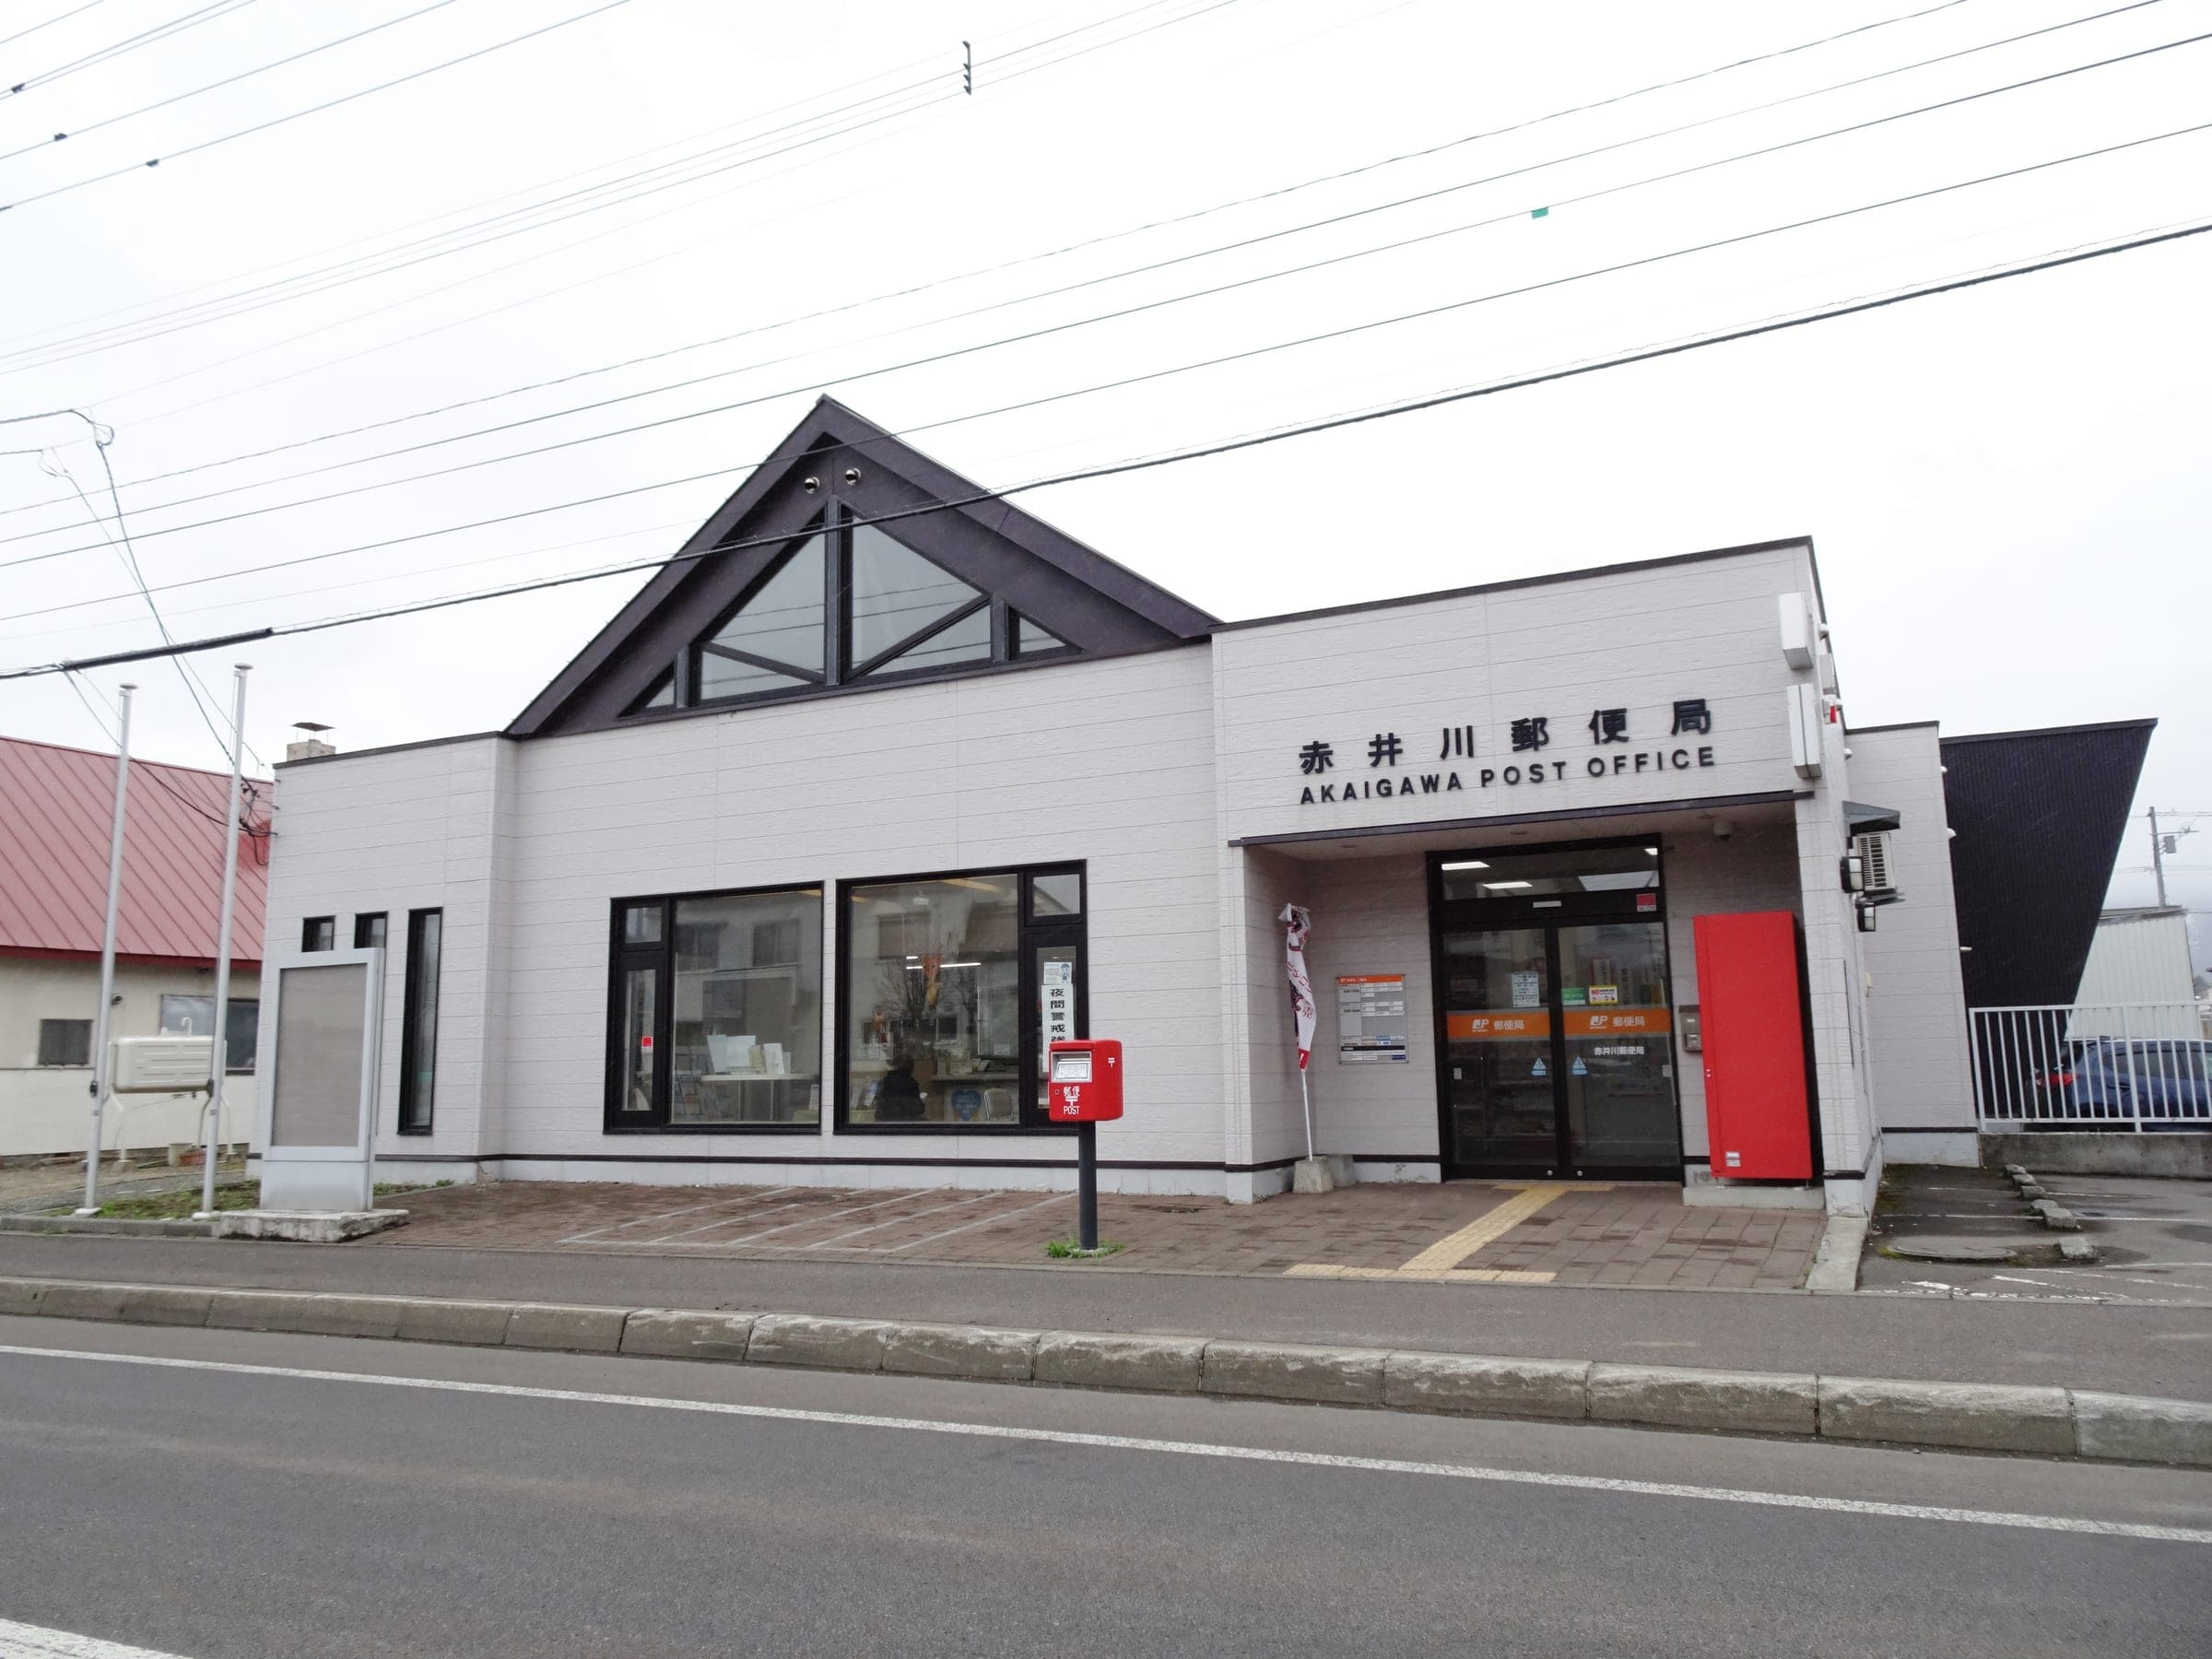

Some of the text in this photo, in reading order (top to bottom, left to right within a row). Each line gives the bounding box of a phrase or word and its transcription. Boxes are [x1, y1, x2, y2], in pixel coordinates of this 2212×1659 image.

[1299, 699, 1712, 774] 赤井川郵便局
[1300, 747, 1714, 805] AKAIGAWA POST OFFICE
[1493, 1019, 1524, 1030] 郵便局
[1613, 1016, 1645, 1027] 郵便局
[1594, 1046, 1645, 1055] 赤井川郵便局
[1063, 1086, 1080, 1097] 郵便
[1063, 1106, 1080, 1115] POST
